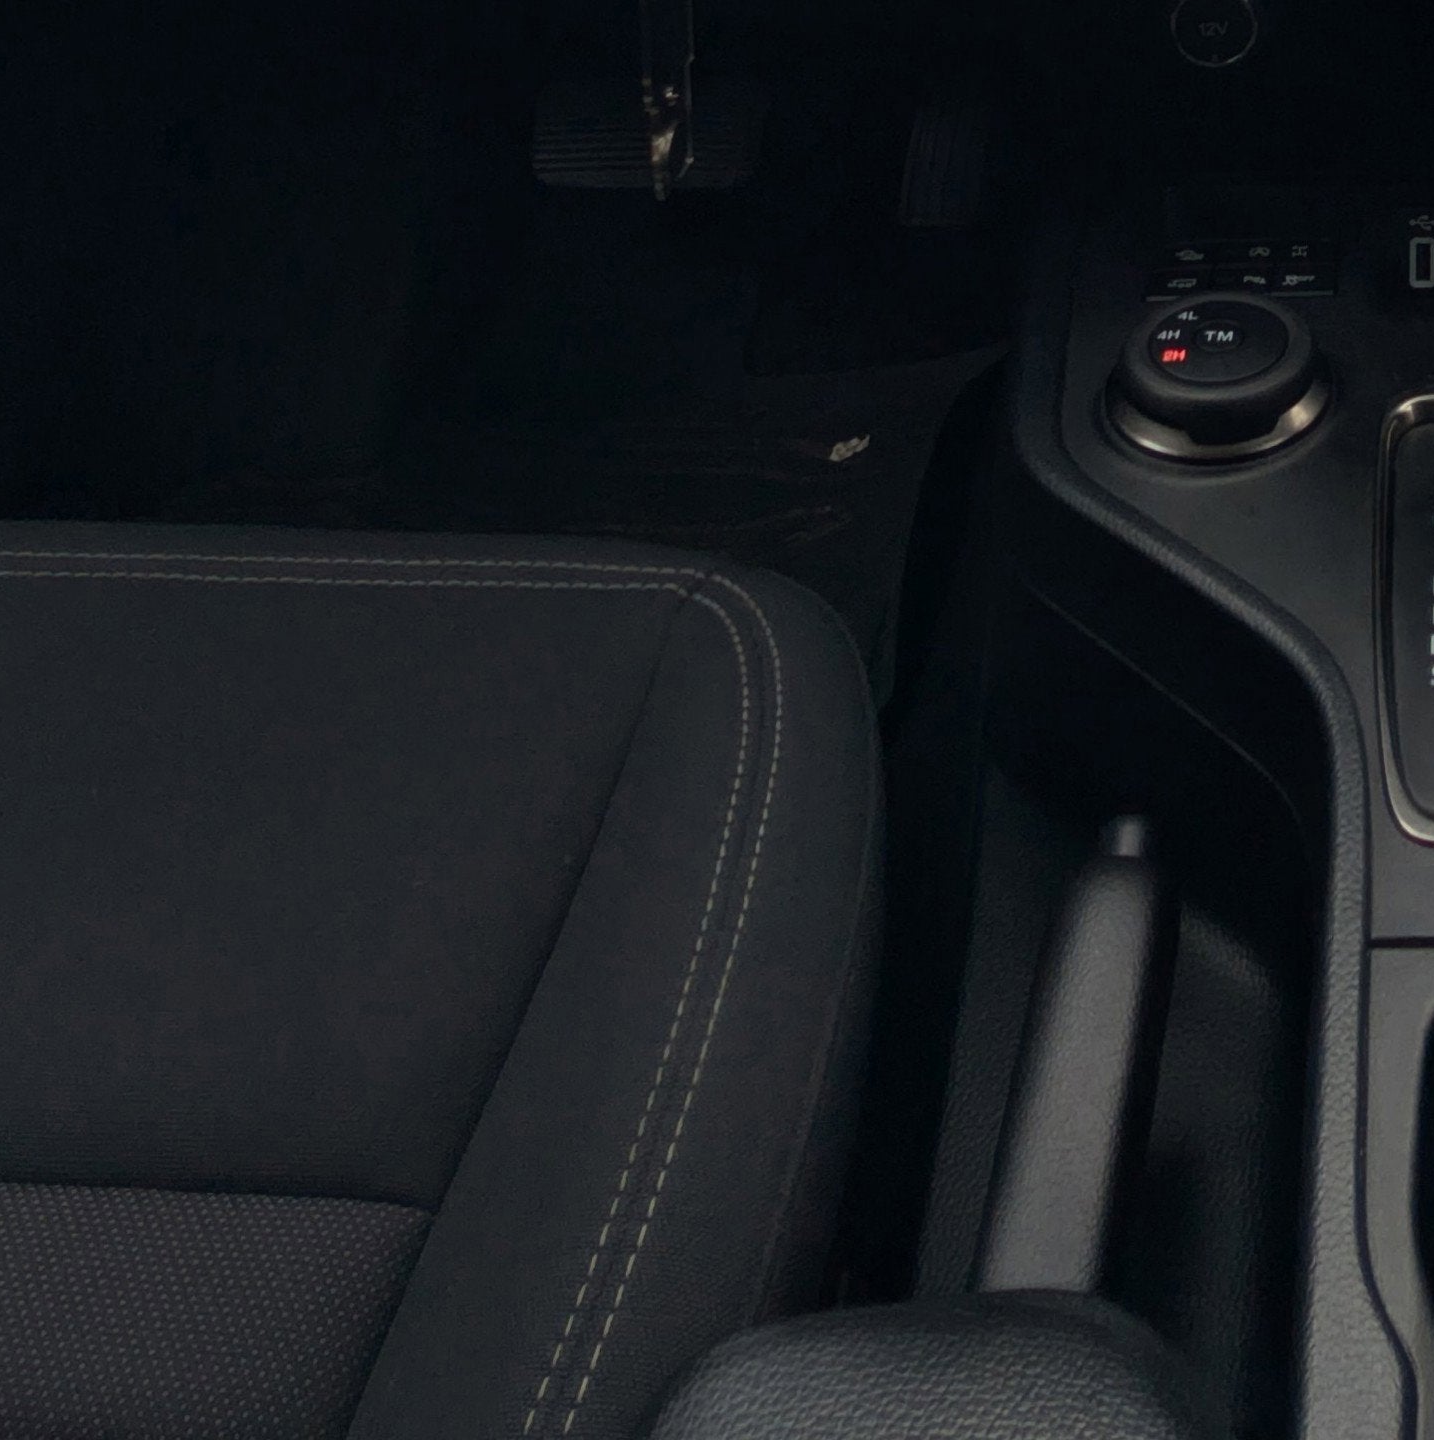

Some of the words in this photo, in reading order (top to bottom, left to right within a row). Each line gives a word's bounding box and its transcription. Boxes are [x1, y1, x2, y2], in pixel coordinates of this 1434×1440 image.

[1198, 20, 1228, 37] 12V
[1178, 310, 1199, 321] 4L
[1157, 329, 1182, 341] 4H
[1204, 330, 1234, 342] TM
[1161, 348, 1187, 363] 2H
